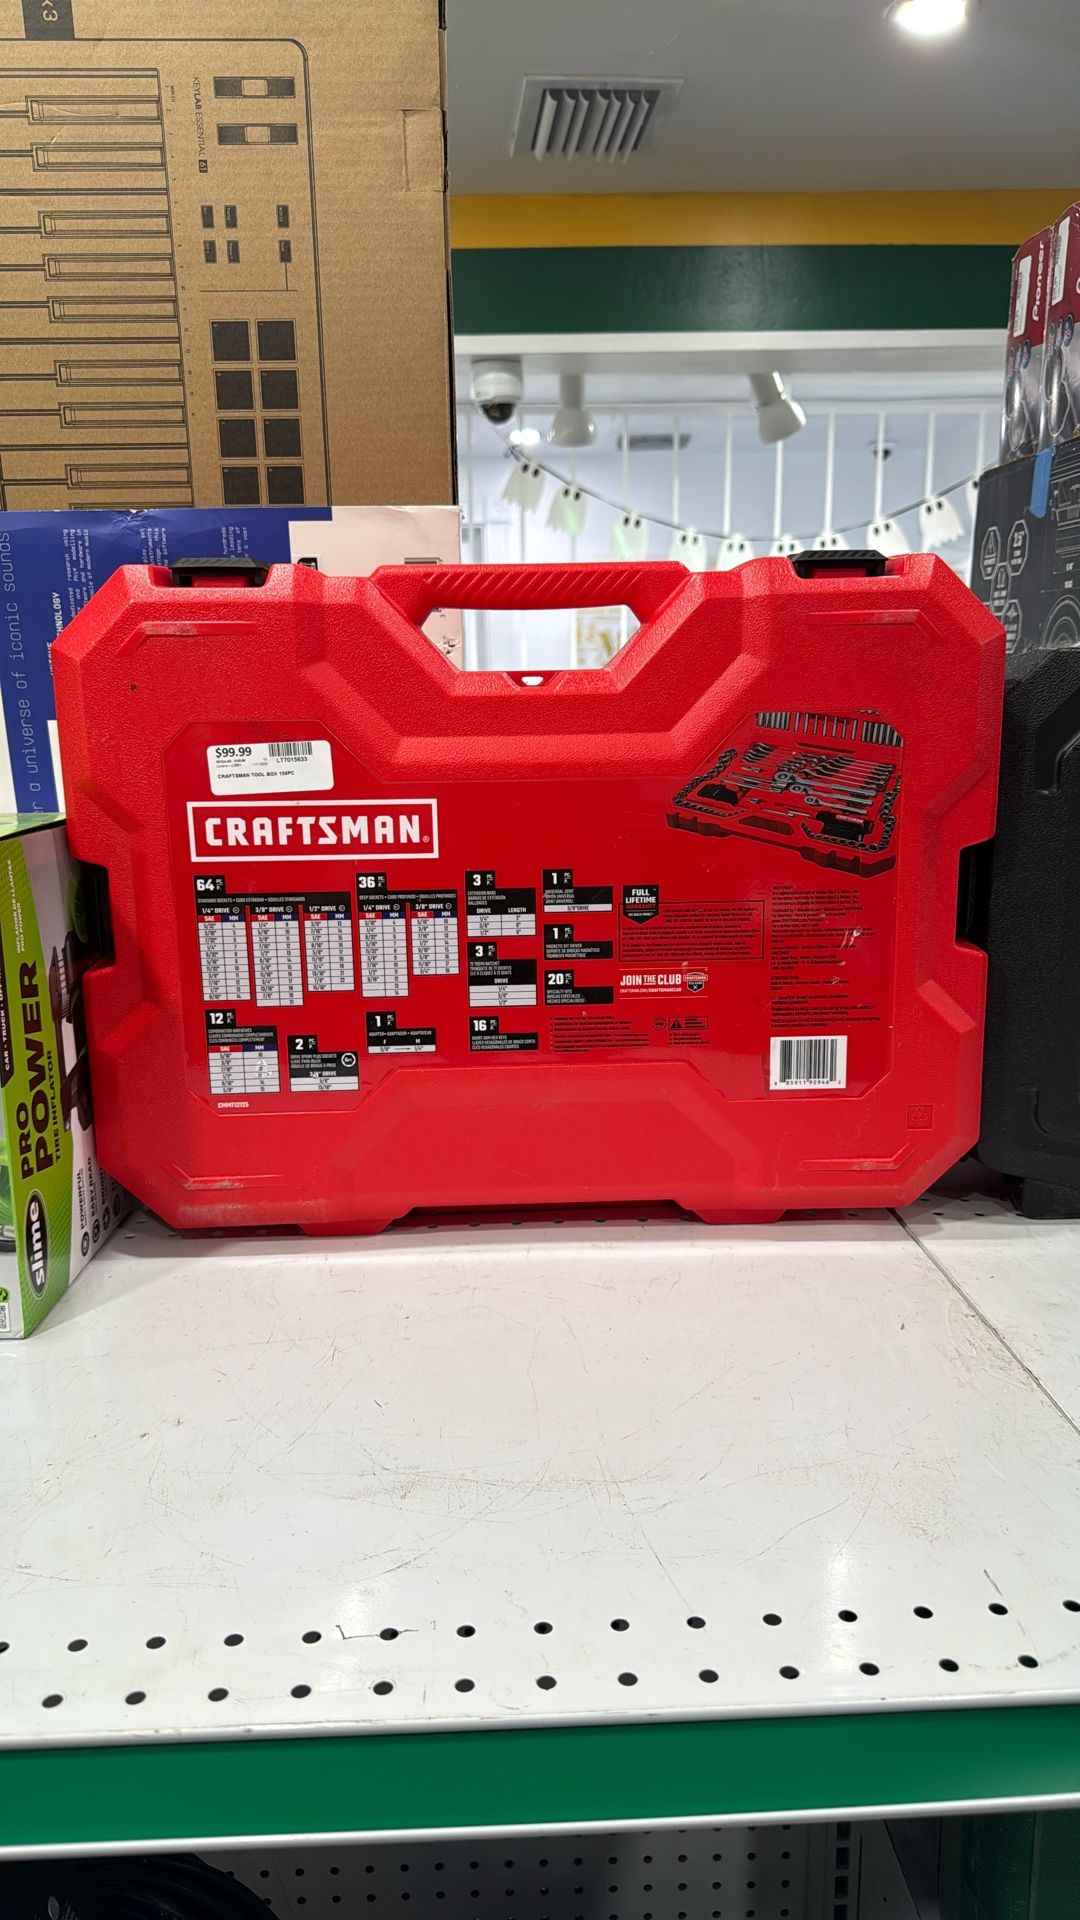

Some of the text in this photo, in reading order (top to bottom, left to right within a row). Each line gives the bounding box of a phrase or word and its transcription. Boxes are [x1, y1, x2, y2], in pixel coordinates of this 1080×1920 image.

[192, 76, 207, 172] KEYLAB ESSENTIAL 61
[1032, 239, 1044, 322] Pioneer
[0, 532, 16, 592] sounds
[6, 602, 24, 660] iconic
[14, 671, 28, 689] of
[18, 700, 38, 774] universe
[216, 746, 252, 758] $99.99
[28, 782, 41, 792] a
[358, 876, 375, 888] 36
[473, 874, 481, 886] 3
[552, 873, 557, 884] 1
[196, 879, 214, 891] 64
[7, 860, 21, 953] INFLADOR DE LLANTAS
[553, 928, 558, 939] 1
[475, 945, 483, 957] 3
[548, 973, 564, 985] 20
[620, 975, 642, 986] JOIN
[658, 974, 682, 985] CLUB
[209, 1013, 224, 1024] 12
[375, 1016, 381, 1027] 1
[473, 1020, 487, 1031] 16
[295, 1038, 304, 1050] 2
[18, 960, 53, 1170] POWER
[46, 1050, 62, 1164] TIRE INFLATOR
[15, 1102, 34, 1180] PRO
[76, 1169, 84, 1230] POWERFUL
[26, 1201, 46, 1286] slime
